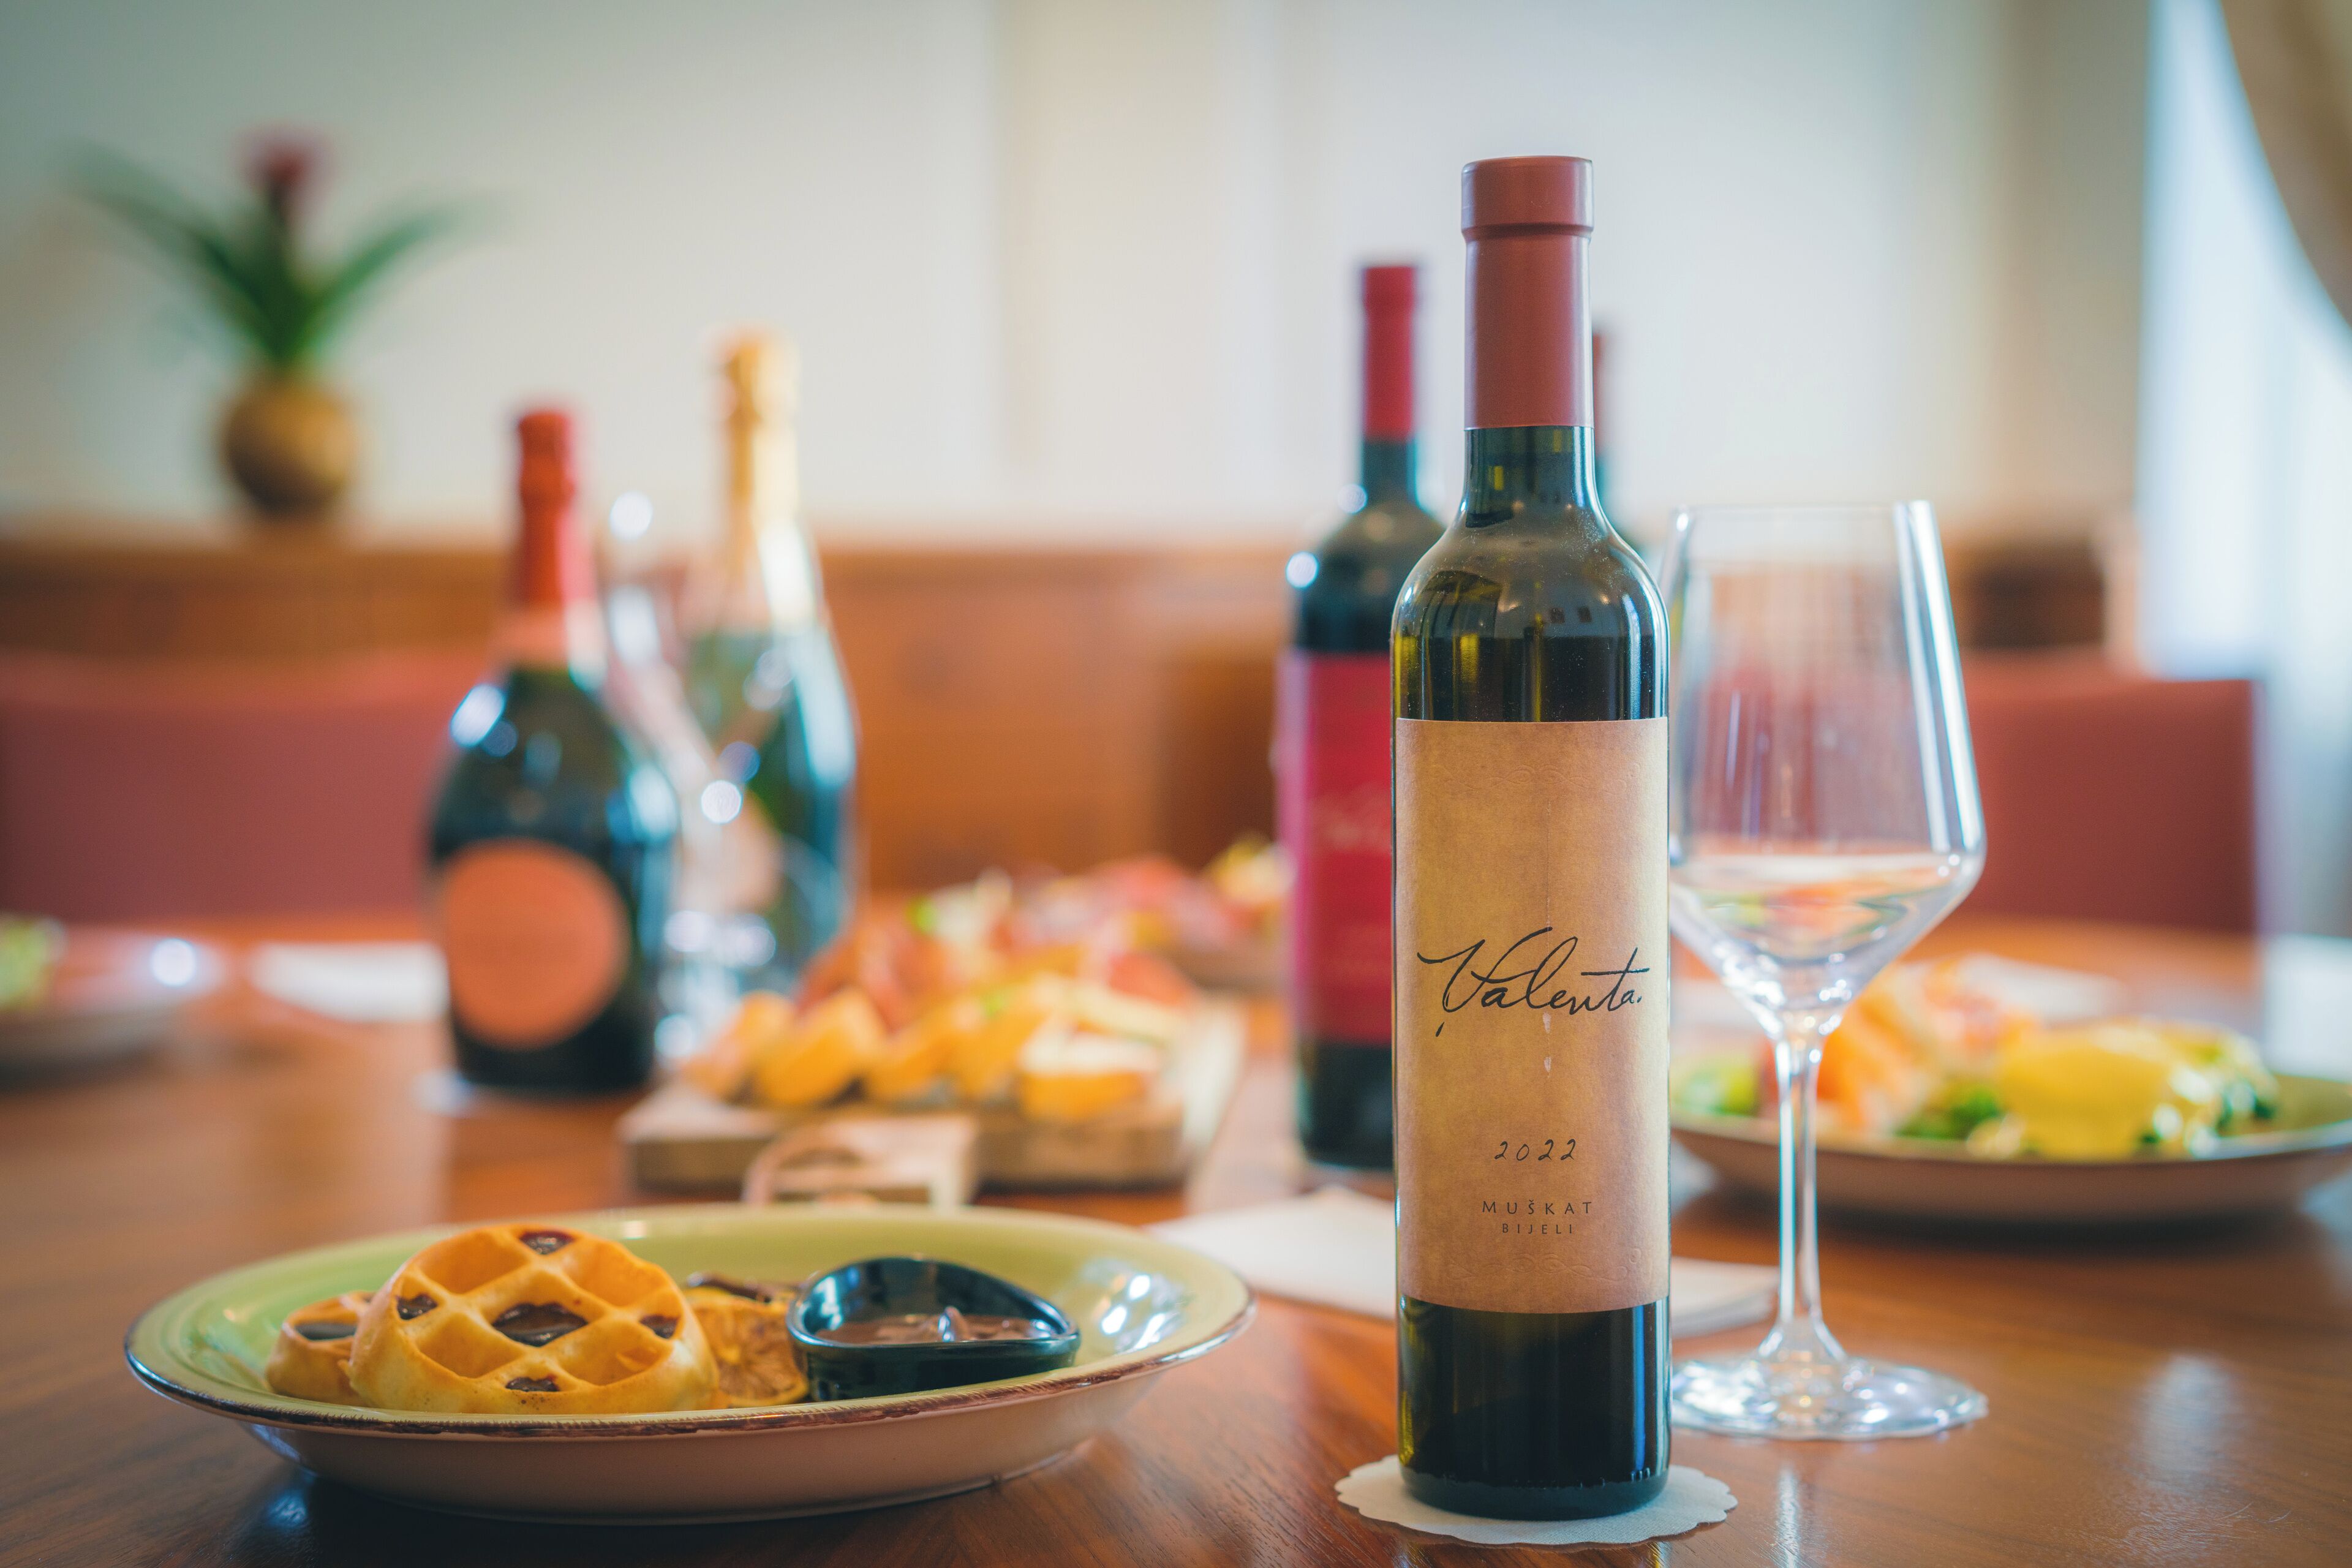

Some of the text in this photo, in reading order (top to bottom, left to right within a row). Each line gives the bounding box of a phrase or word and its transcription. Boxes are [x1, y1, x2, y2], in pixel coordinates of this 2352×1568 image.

[1494, 1139, 1576, 1161] 2022
[1482, 1199, 1592, 1215] MUŠKAT
[1502, 1223, 1573, 1235] BIJELI
